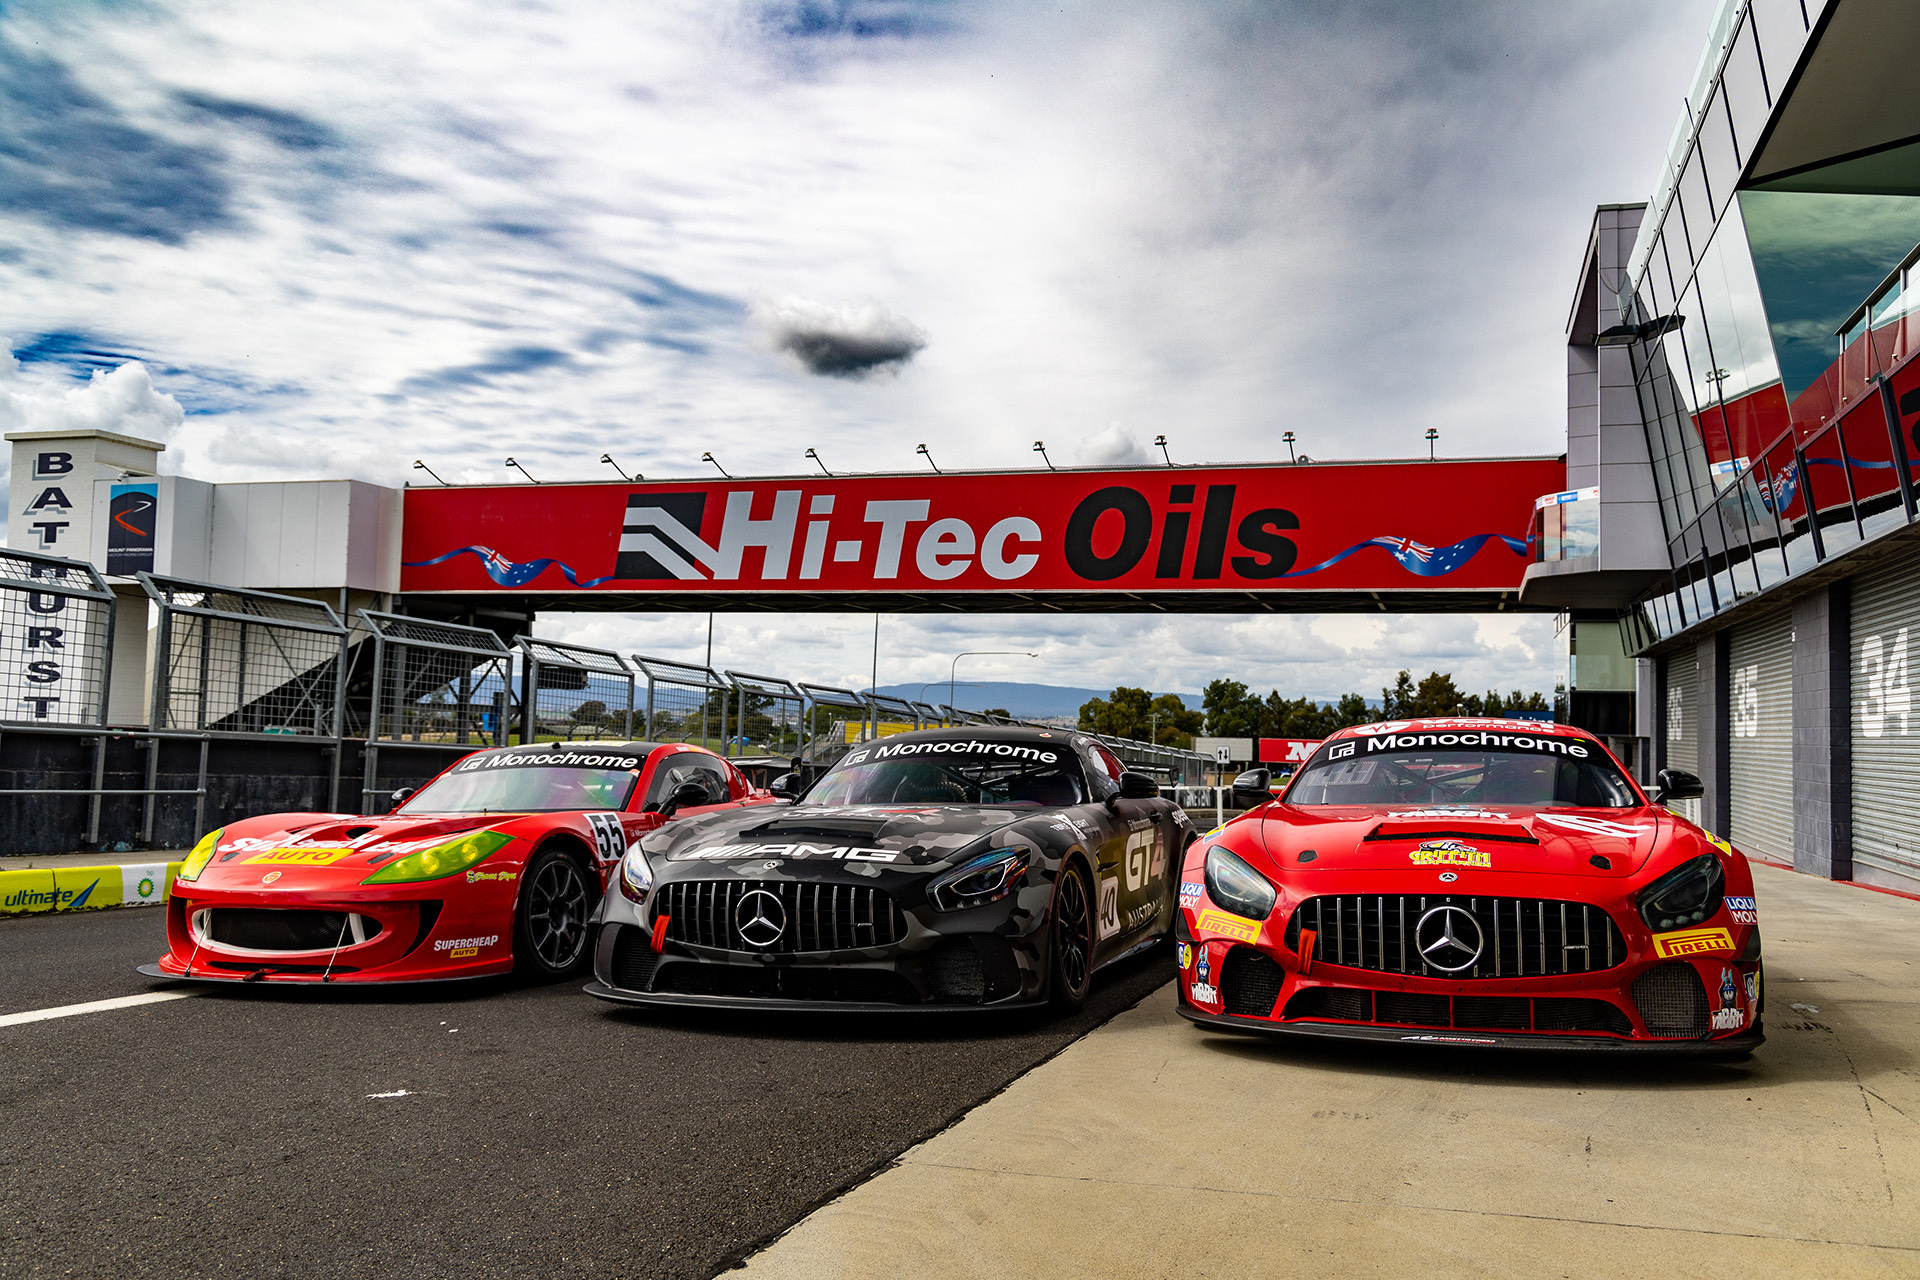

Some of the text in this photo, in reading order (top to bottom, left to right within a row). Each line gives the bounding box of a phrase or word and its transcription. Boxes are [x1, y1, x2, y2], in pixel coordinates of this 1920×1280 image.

[714, 484, 1300, 581] Hi-Tec Oils
[1860, 627, 1911, 738] 34
[1735, 665, 1758, 737] 35
[1422, 723, 1555, 734] performance
[875, 740, 1058, 764] Monochrome
[1367, 732, 1589, 758] Monochrome
[485, 751, 639, 769] Monochrome
[588, 815, 625, 859] 55
[263, 851, 334, 861] AUTO
[752, 844, 901, 862] AMG
[1125, 826, 1166, 892] GT4
[1409, 849, 1492, 864] GRIFFITH
[5, 888, 73, 906] ultimate
[1101, 886, 1116, 930] 40
[1726, 898, 1757, 910] LIQUI
[1200, 913, 1256, 942] PIRELLI
[434, 935, 499, 951] SUPERCHEAP
[1660, 933, 1730, 957] PIRELLI
